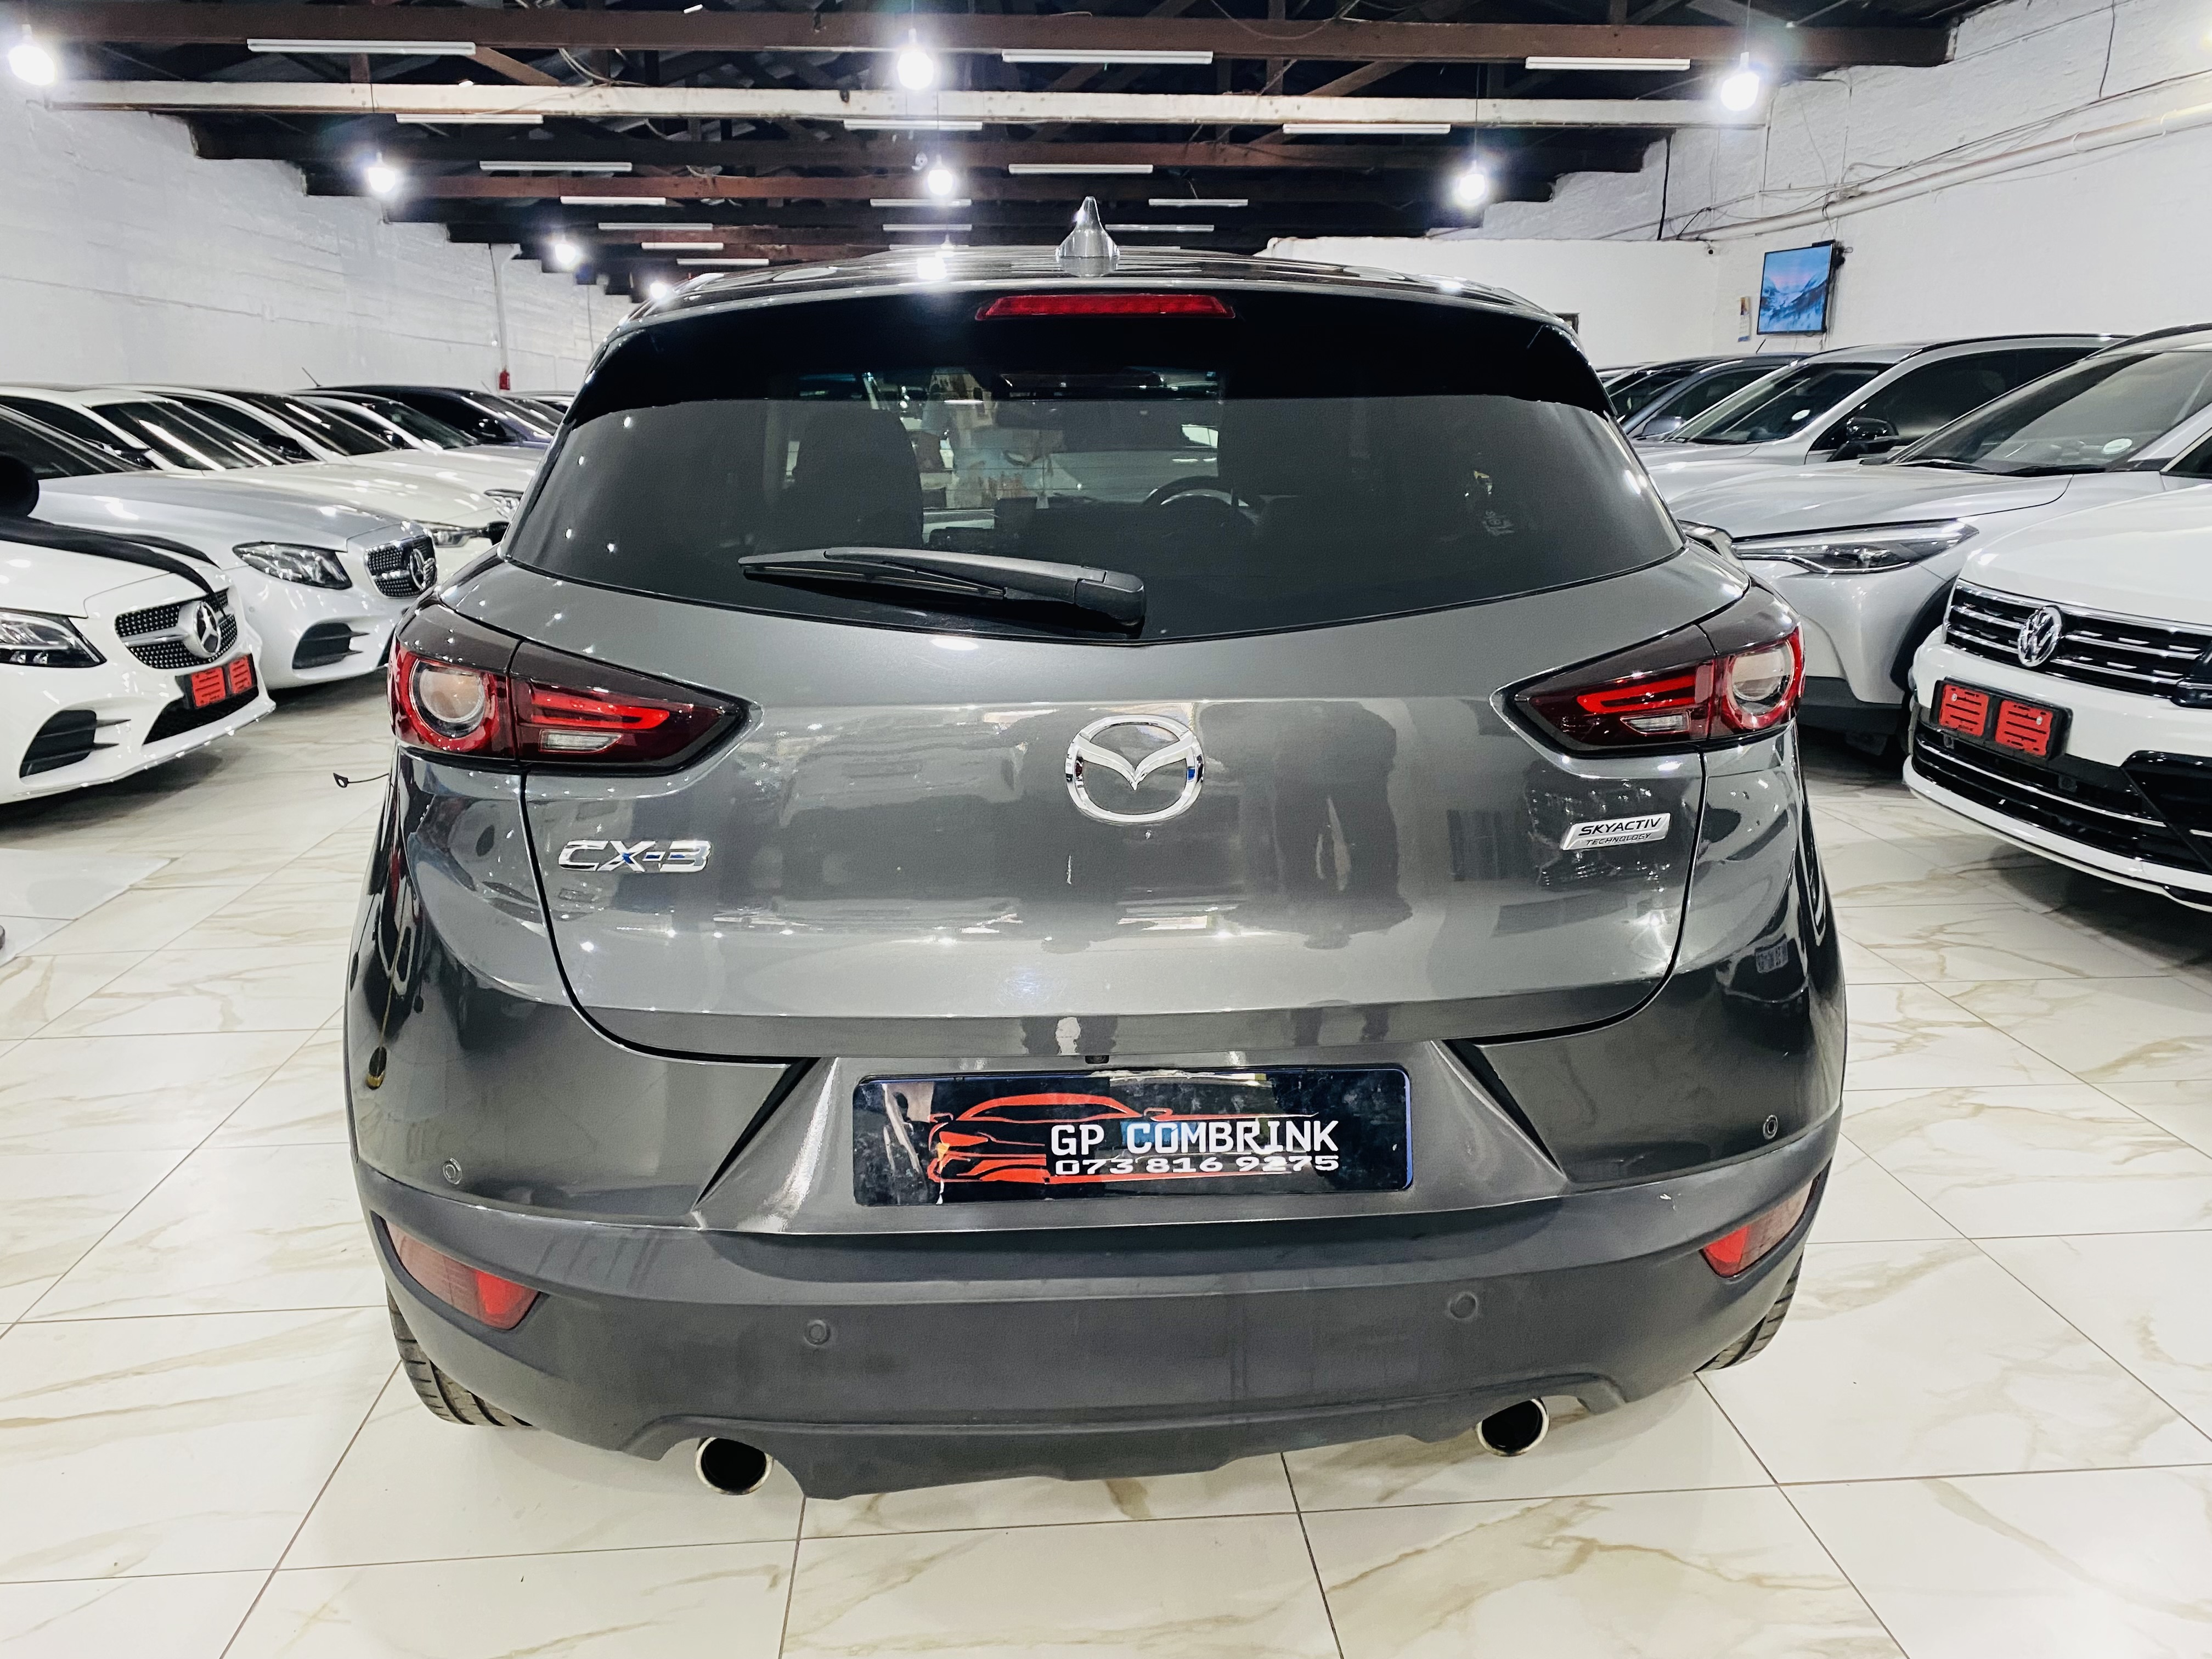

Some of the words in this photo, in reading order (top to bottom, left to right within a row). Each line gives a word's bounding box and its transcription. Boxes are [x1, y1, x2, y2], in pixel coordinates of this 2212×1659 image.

[1578, 817, 1662, 836] SKYACTIV
[1586, 833, 1652, 845] TECHNOLOGY
[558, 839, 712, 873] CX-3
[1051, 1124, 1104, 1155] GP
[1126, 1119, 1339, 1154] COMBRINK
[1055, 1158, 1133, 1175] 073
[1146, 1156, 1223, 1173] 816
[1235, 1155, 1339, 1172] 9275
